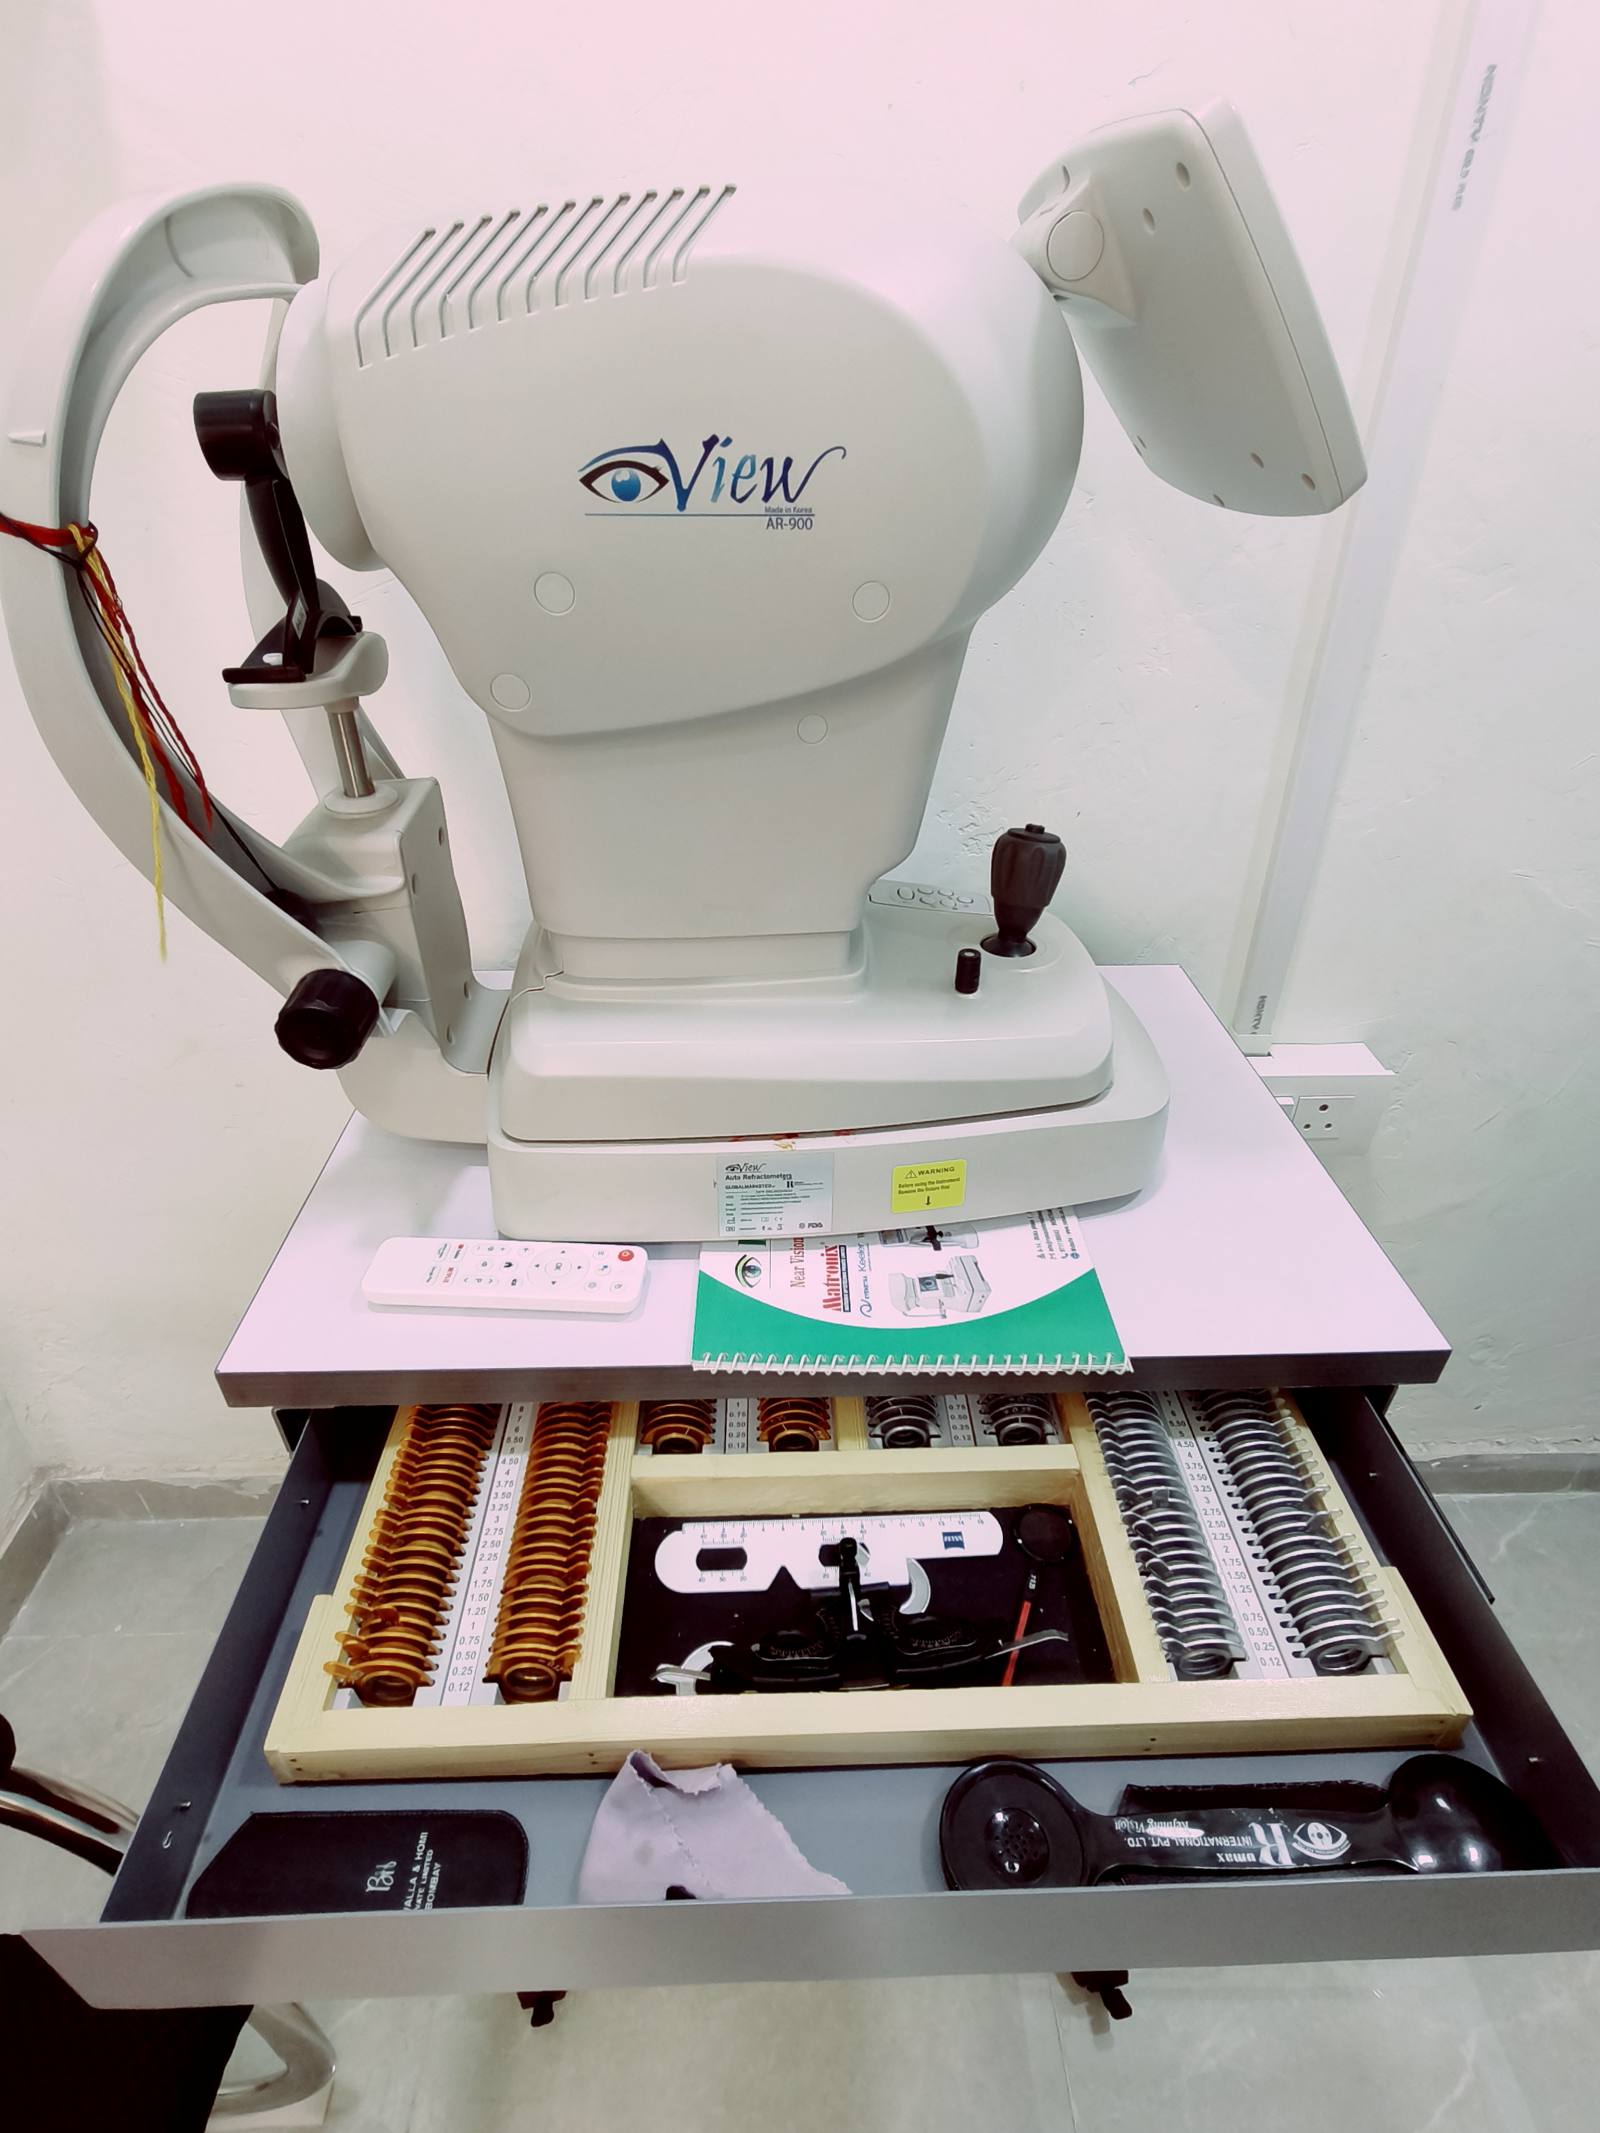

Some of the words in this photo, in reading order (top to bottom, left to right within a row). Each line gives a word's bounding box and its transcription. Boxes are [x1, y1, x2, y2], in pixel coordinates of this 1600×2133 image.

[766, 517, 813, 530] AR-900
[918, 1166, 955, 1176] WARNING
[790, 1237, 805, 1264] Vision
[857, 1242, 867, 1272] Keeler
[790, 1266, 806, 1288] Near
[821, 1245, 842, 1312] Matronix
[500, 1457, 519, 1465] 4.50
[496, 1480, 514, 1488] 3.75
[1202, 1508, 1221, 1516] 2.75
[484, 1528, 504, 1536] 2.75
[1212, 1533, 1231, 1541] 2.25
[481, 1540, 501, 1548] 2.50
[479, 1553, 498, 1561] 2.25
[1222, 1559, 1241, 1567] 1.75
[1227, 1571, 1246, 1580] 1.50
[473, 1580, 492, 1588] 1.75
[1232, 1585, 1252, 1593] 1.25
[470, 1593, 489, 1601] 1.50
[1245, 1599, 1249, 1607] 1
[467, 1607, 486, 1615] 1.25
[1242, 1613, 1263, 1621] 0.75
[471, 1622, 475, 1630] 1
[1248, 1627, 1269, 1636] 0.50
[459, 1636, 480, 1644] 0.75
[1254, 1642, 1275, 1650] 0.25
[456, 1652, 477, 1660] 0.50
[1260, 1658, 1281, 1666] 0.12
[452, 1667, 473, 1675] 0.25
[448, 1683, 470, 1691] 0.12
[1124, 1837, 1147, 1847] LTD.
[1150, 1837, 1170, 1847] PVT.
[1175, 1835, 1253, 1847] INTERNATIONAL
[415, 1831, 429, 1860] HOMI
[421, 1849, 433, 1884] LIMITED
[424, 1862, 442, 1910] BOMBAY
